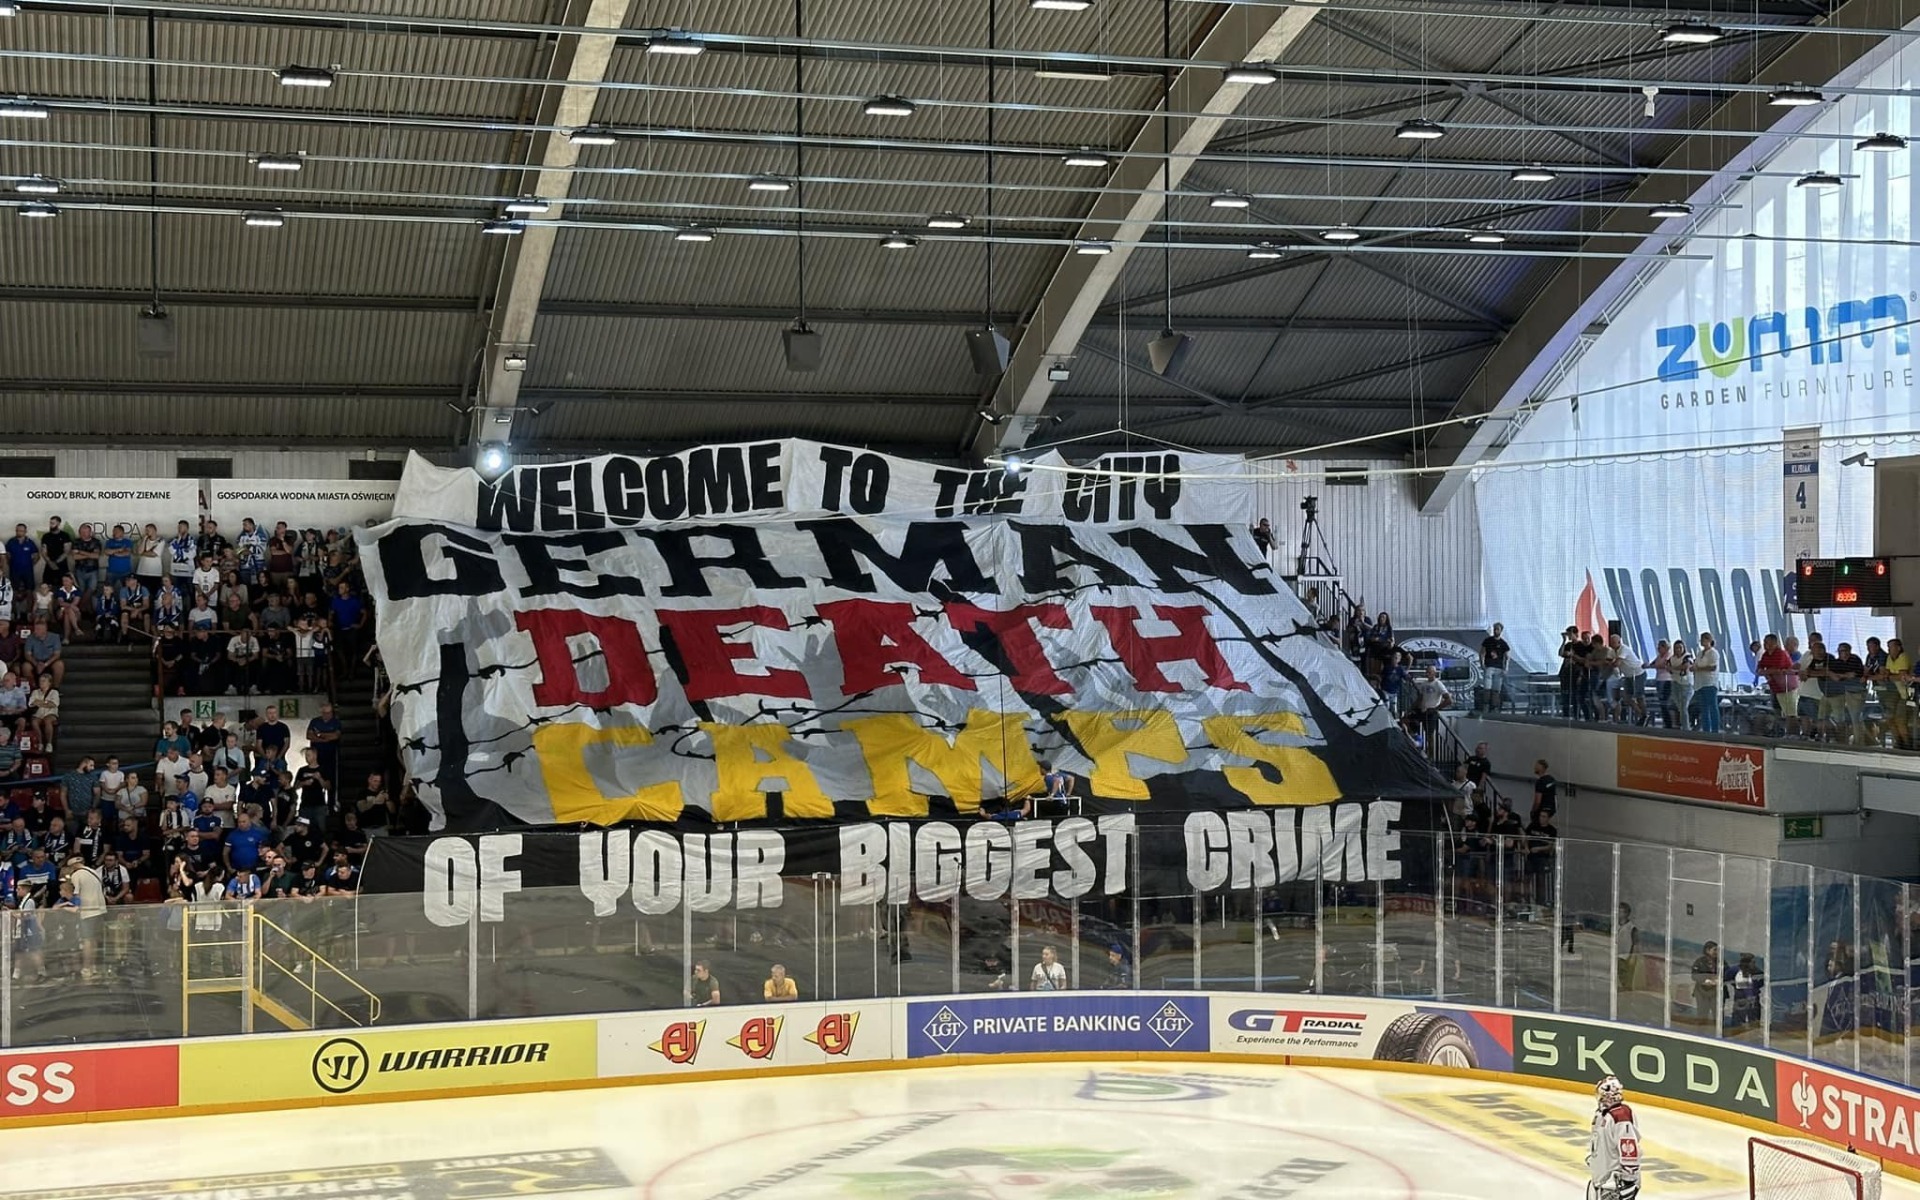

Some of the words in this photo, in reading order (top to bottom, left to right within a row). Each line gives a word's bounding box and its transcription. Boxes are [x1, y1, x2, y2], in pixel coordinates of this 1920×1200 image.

[1661, 385, 1748, 411] GARDEN
[1765, 368, 1914, 400] FURNITURE
[26, 490, 67, 501] OGRODY,
[69, 490, 96, 501] BRUK,
[98, 490, 135, 500] ROBOTY
[136, 490, 171, 500] ZIEMNE
[217, 491, 279, 501] GOSPODARKA
[280, 491, 316, 501] WODNA
[317, 492, 350, 501] MIASTA
[475, 442, 784, 532] WELCOME
[820, 445, 890, 515] TO
[933, 466, 1032, 518] THE
[1062, 453, 1182, 524] CITY
[1795, 481, 1807, 510] 4
[83, 521, 143, 541] RUPA
[378, 513, 1278, 600] GERMAN
[514, 598, 1253, 708] DEATH
[532, 706, 1344, 827] CAMPS
[423, 833, 523, 928] OF
[579, 828, 786, 917] YOUR
[839, 813, 1137, 906] BIGGEST
[1184, 801, 1402, 892] CRIME
[929, 1021, 962, 1037] LGT
[972, 1015, 1048, 1035] PRIVATE
[1053, 1014, 1142, 1033] BANKING
[1154, 1016, 1188, 1033] LGT
[1228, 1009, 1304, 1033] GT
[1303, 1019, 1364, 1031] RADIAL
[378, 1041, 550, 1074] WARRIOR
[1236, 1035, 1285, 1046] Experience
[1287, 1037, 1301, 1046] the
[1303, 1037, 1359, 1049] Performance
[6, 1061, 76, 1106] SS
[1821, 1084, 1920, 1156] STRA
